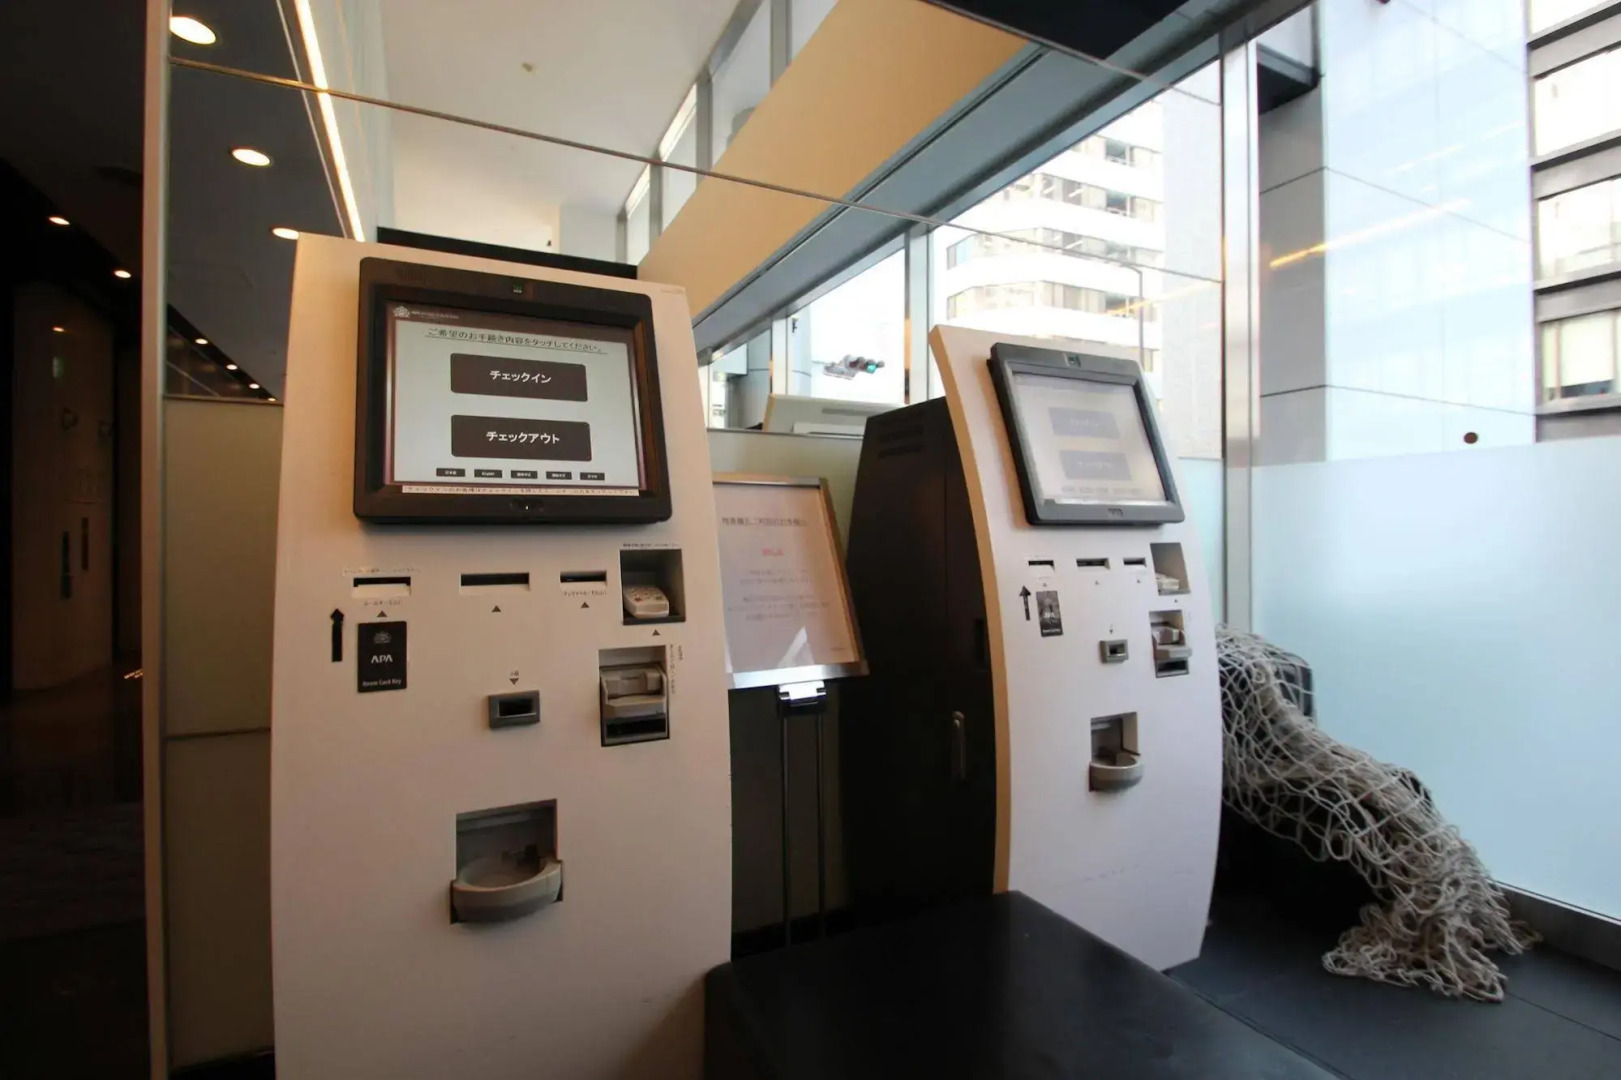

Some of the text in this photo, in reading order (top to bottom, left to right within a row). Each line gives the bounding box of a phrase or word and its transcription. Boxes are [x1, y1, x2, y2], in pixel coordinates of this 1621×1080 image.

[489, 370, 552, 384] チェックイン
[485, 431, 560, 444] チェックアウト
[371, 654, 393, 663] APA
